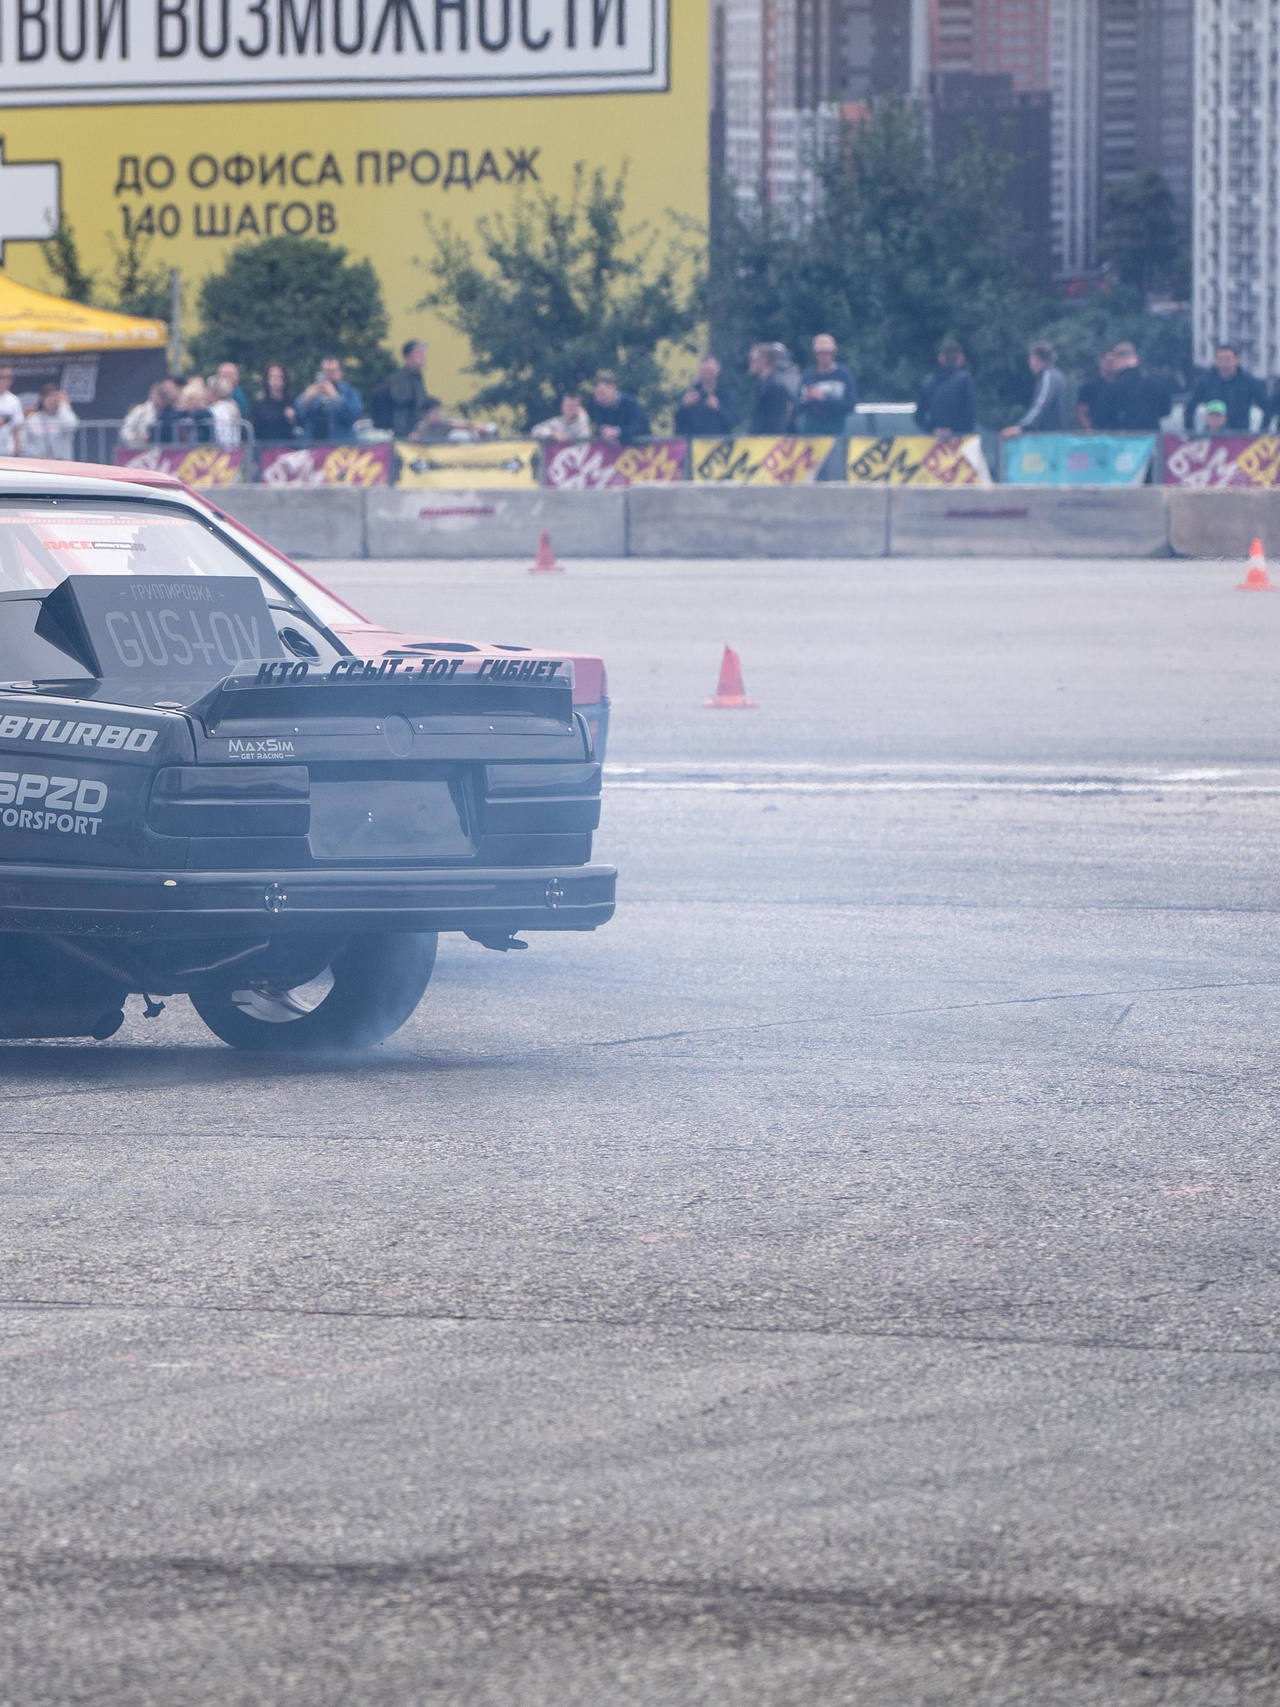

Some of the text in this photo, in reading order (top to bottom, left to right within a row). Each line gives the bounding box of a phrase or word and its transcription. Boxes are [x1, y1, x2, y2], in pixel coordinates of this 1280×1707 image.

[156, 0, 626, 58] ВОЗМОЖНОСТИ
[114, 147, 541, 196] ДО ОФИСА ПРОДАЖ
[121, 201, 339, 238] 140 ШАГОВ
[131, 583, 214, 602] ГРУППИРОВКА
[254, 661, 309, 685] КТО
[329, 659, 404, 682] ССЫТ
[420, 658, 464, 681] ТОТ
[475, 659, 563, 683] ГИБНЕТ
